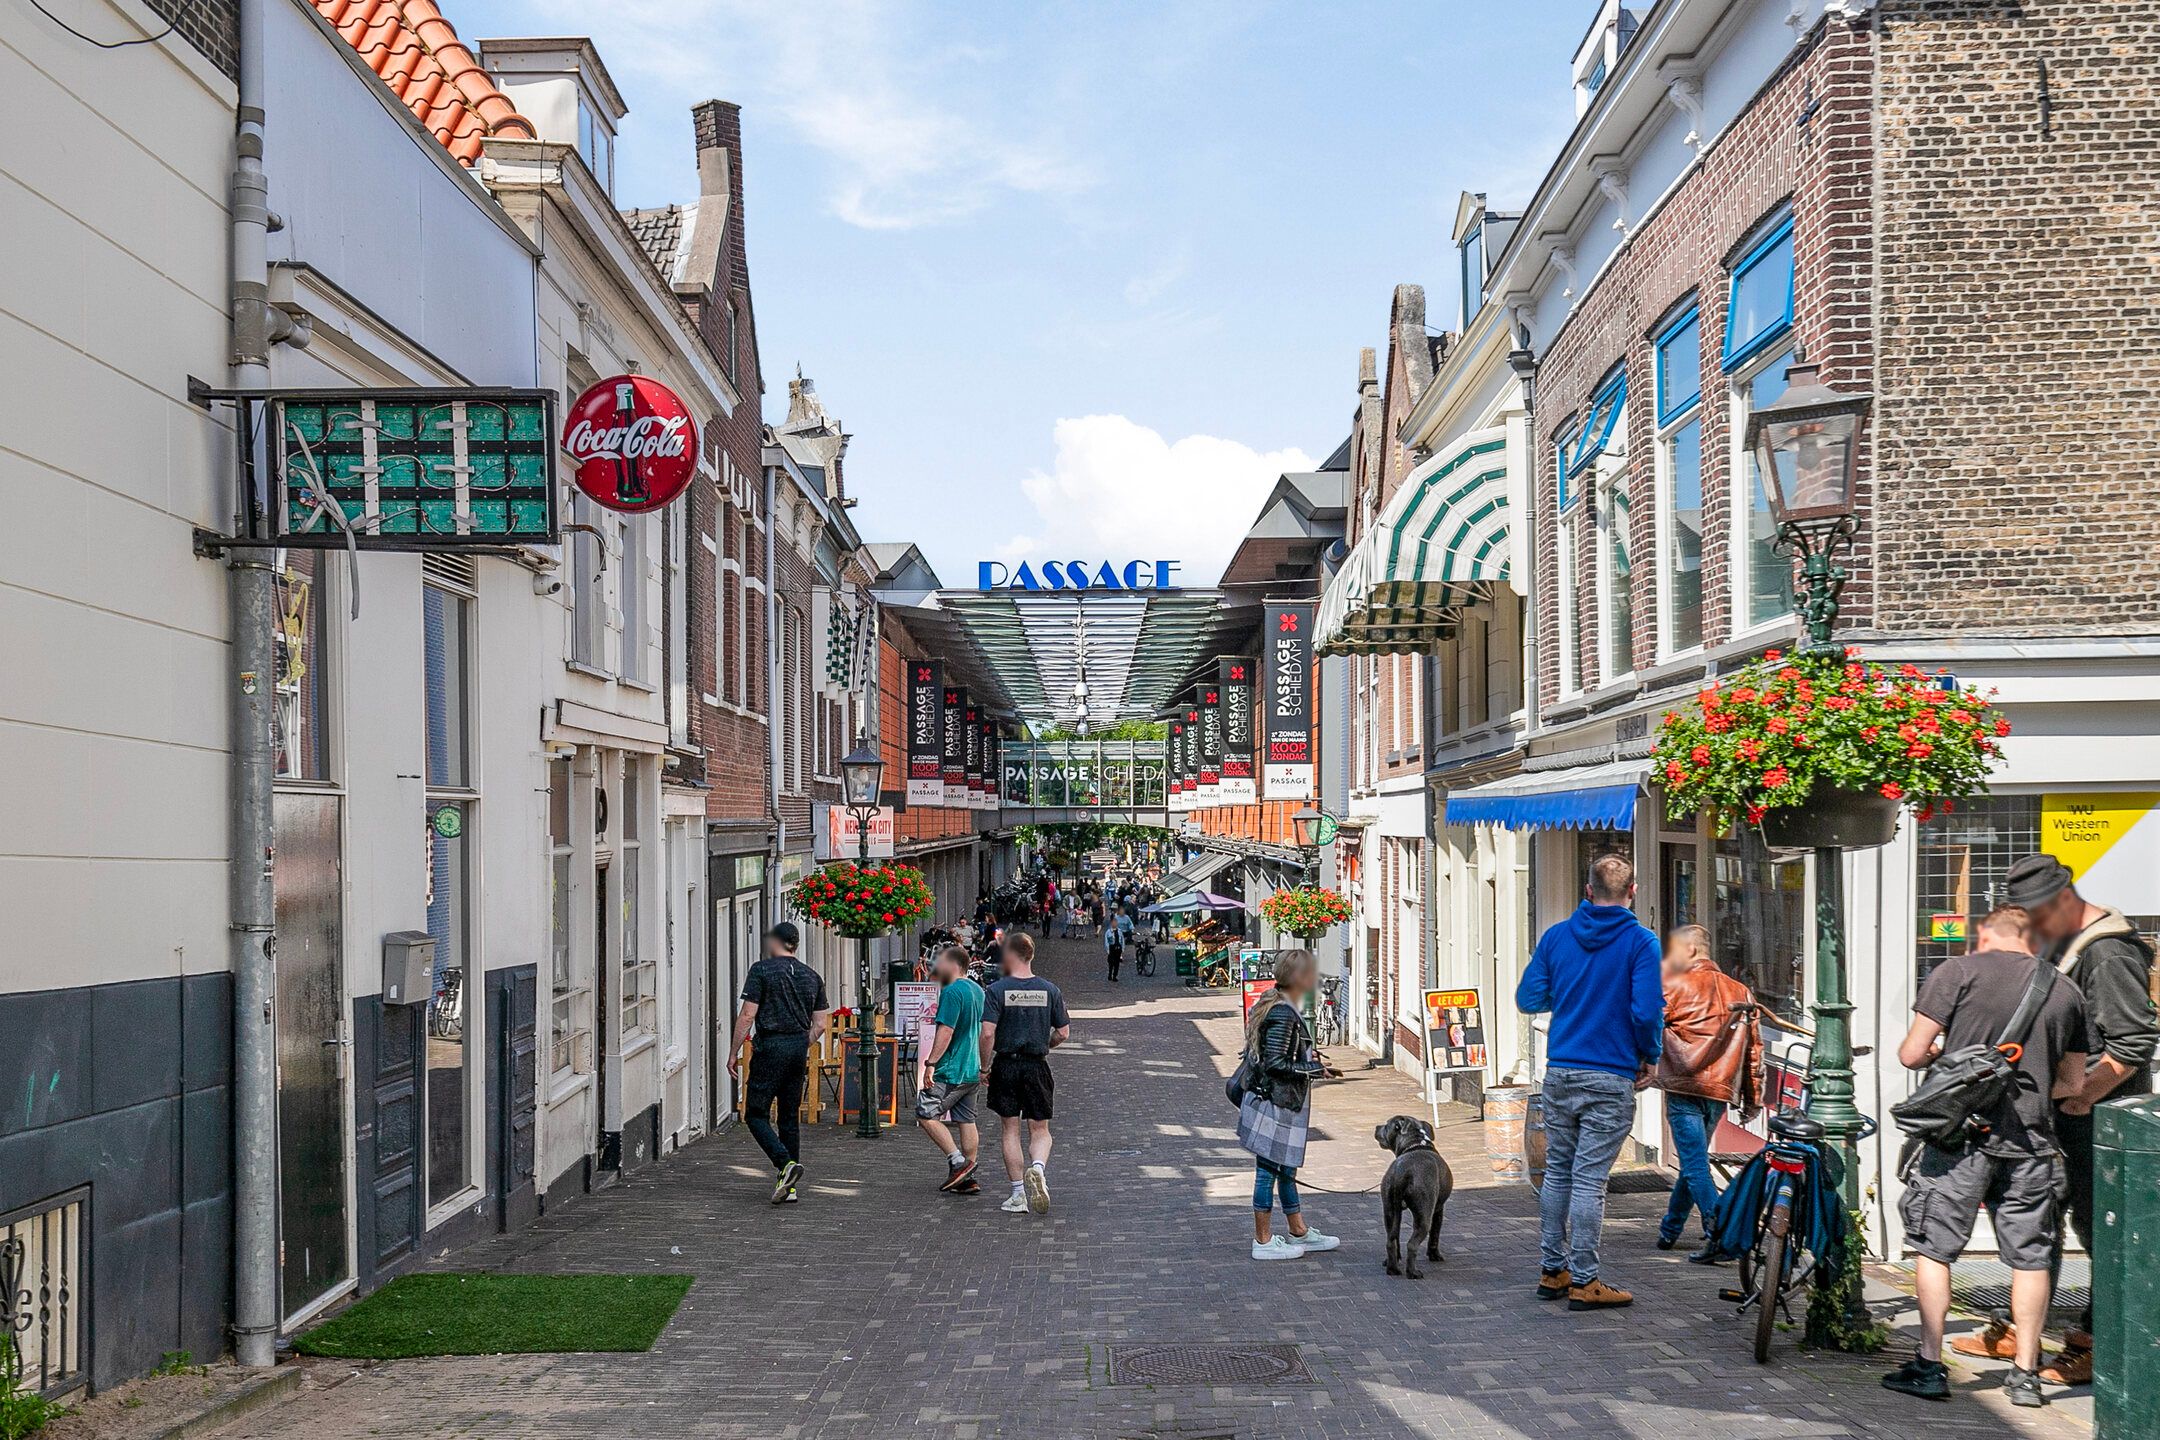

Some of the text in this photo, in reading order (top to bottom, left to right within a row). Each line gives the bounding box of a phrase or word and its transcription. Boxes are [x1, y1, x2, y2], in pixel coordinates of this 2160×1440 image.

[566, 415, 688, 461] Coca-Cola
[978, 559, 1182, 591] PASSAGE
[1276, 638, 1290, 716] PASSAGE
[1290, 638, 1302, 716] SCHIEDAM
[916, 686, 926, 744] PASSAGE
[926, 686, 935, 744] SCHIEDAM
[945, 708, 954, 756] PASSAGE
[1204, 708, 1213, 756] PASSAGE
[1228, 685, 1238, 742] PASSAGE
[1238, 685, 1248, 742] SCHIEDAM
[1271, 743, 1307, 753] KOOP
[1005, 766, 1089, 780] PASSAGE
[878, 820, 891, 834] CITY
[2053, 818, 2110, 829] Western
[2067, 804, 2095, 815] WU
[2062, 830, 2101, 842] Union
[1438, 996, 1451, 1006] LET
